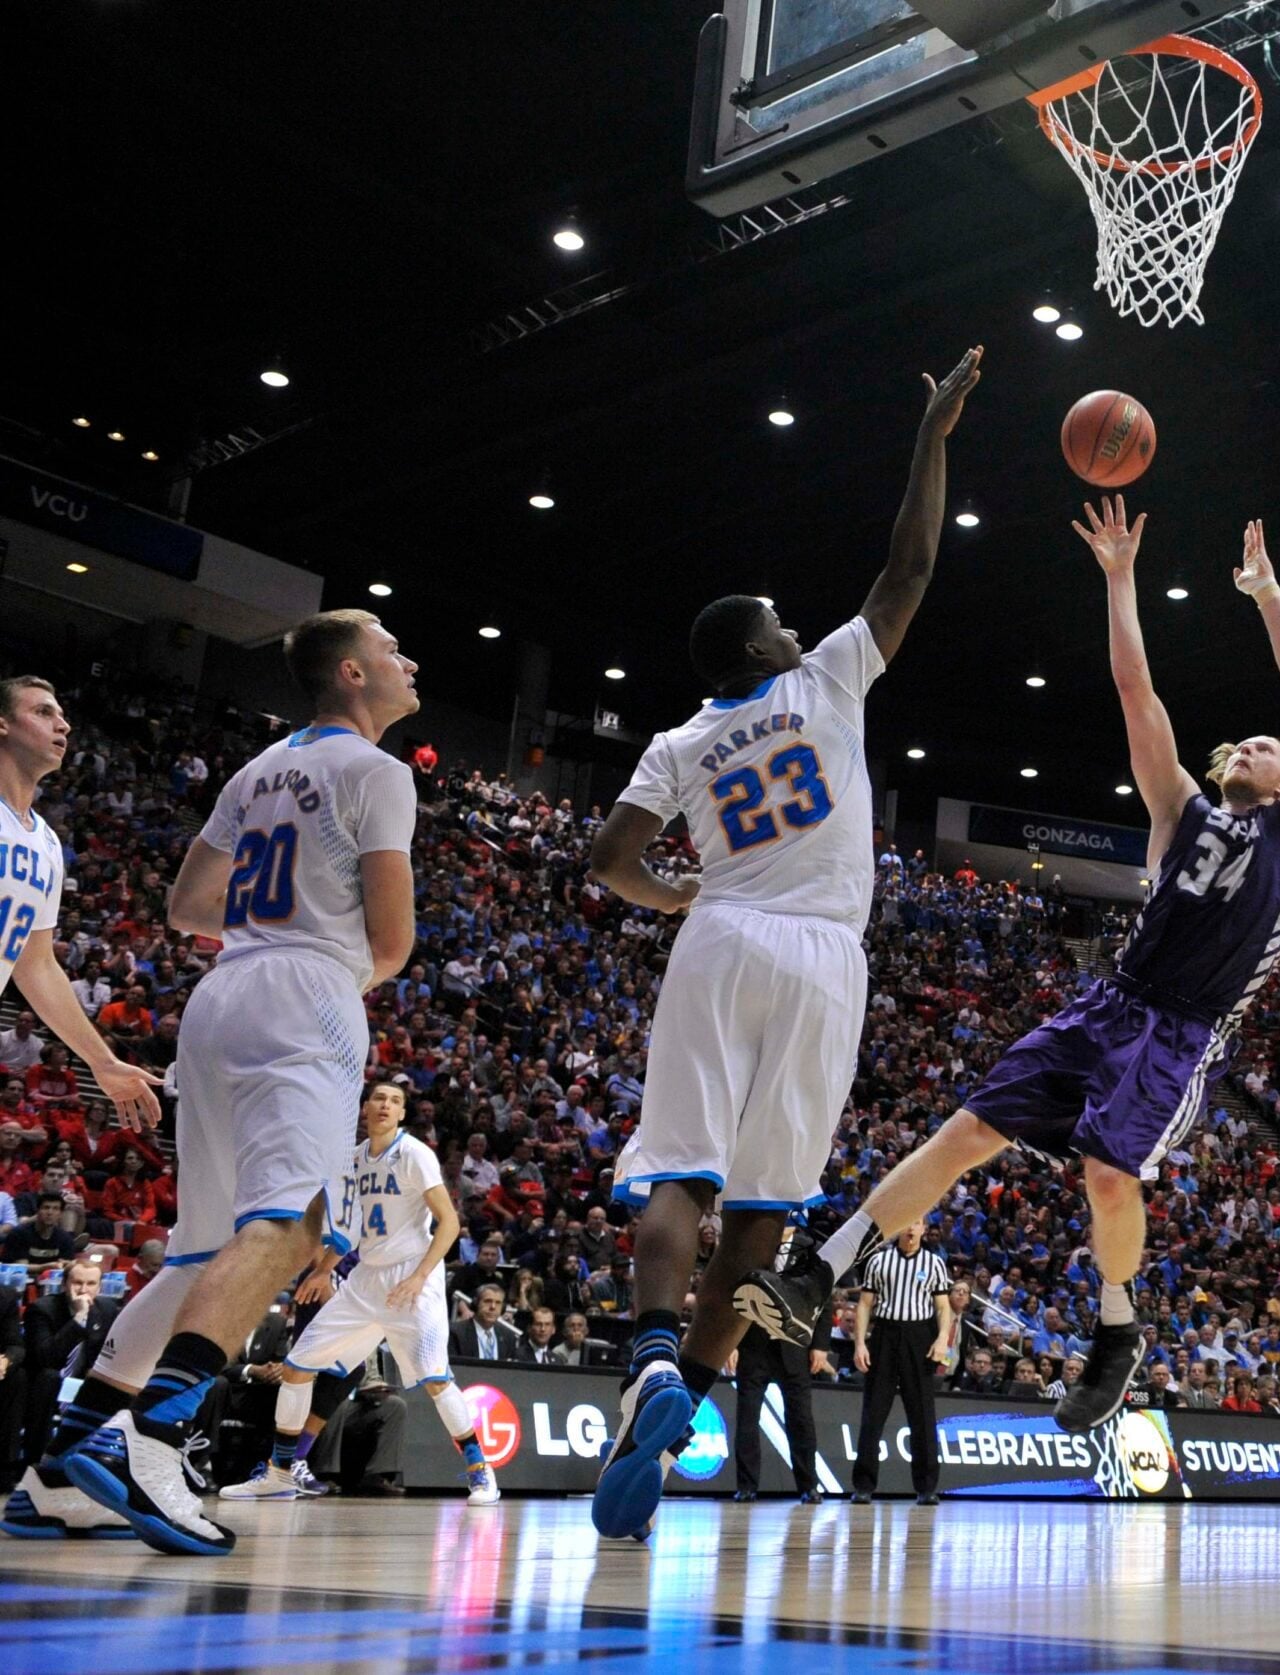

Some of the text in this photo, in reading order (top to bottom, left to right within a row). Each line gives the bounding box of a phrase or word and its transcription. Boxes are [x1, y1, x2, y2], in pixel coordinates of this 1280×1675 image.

[31, 485, 88, 522] VCU
[700, 712, 804, 773] PARKER
[707, 740, 835, 856] 23
[1022, 824, 1115, 852] GONZAGA
[1176, 831, 1254, 902] 34
[222, 820, 300, 930] 20
[355, 1172, 401, 1196] CLA
[533, 1402, 609, 1459] LG
[896, 1427, 1092, 1468] CLEBRATES
